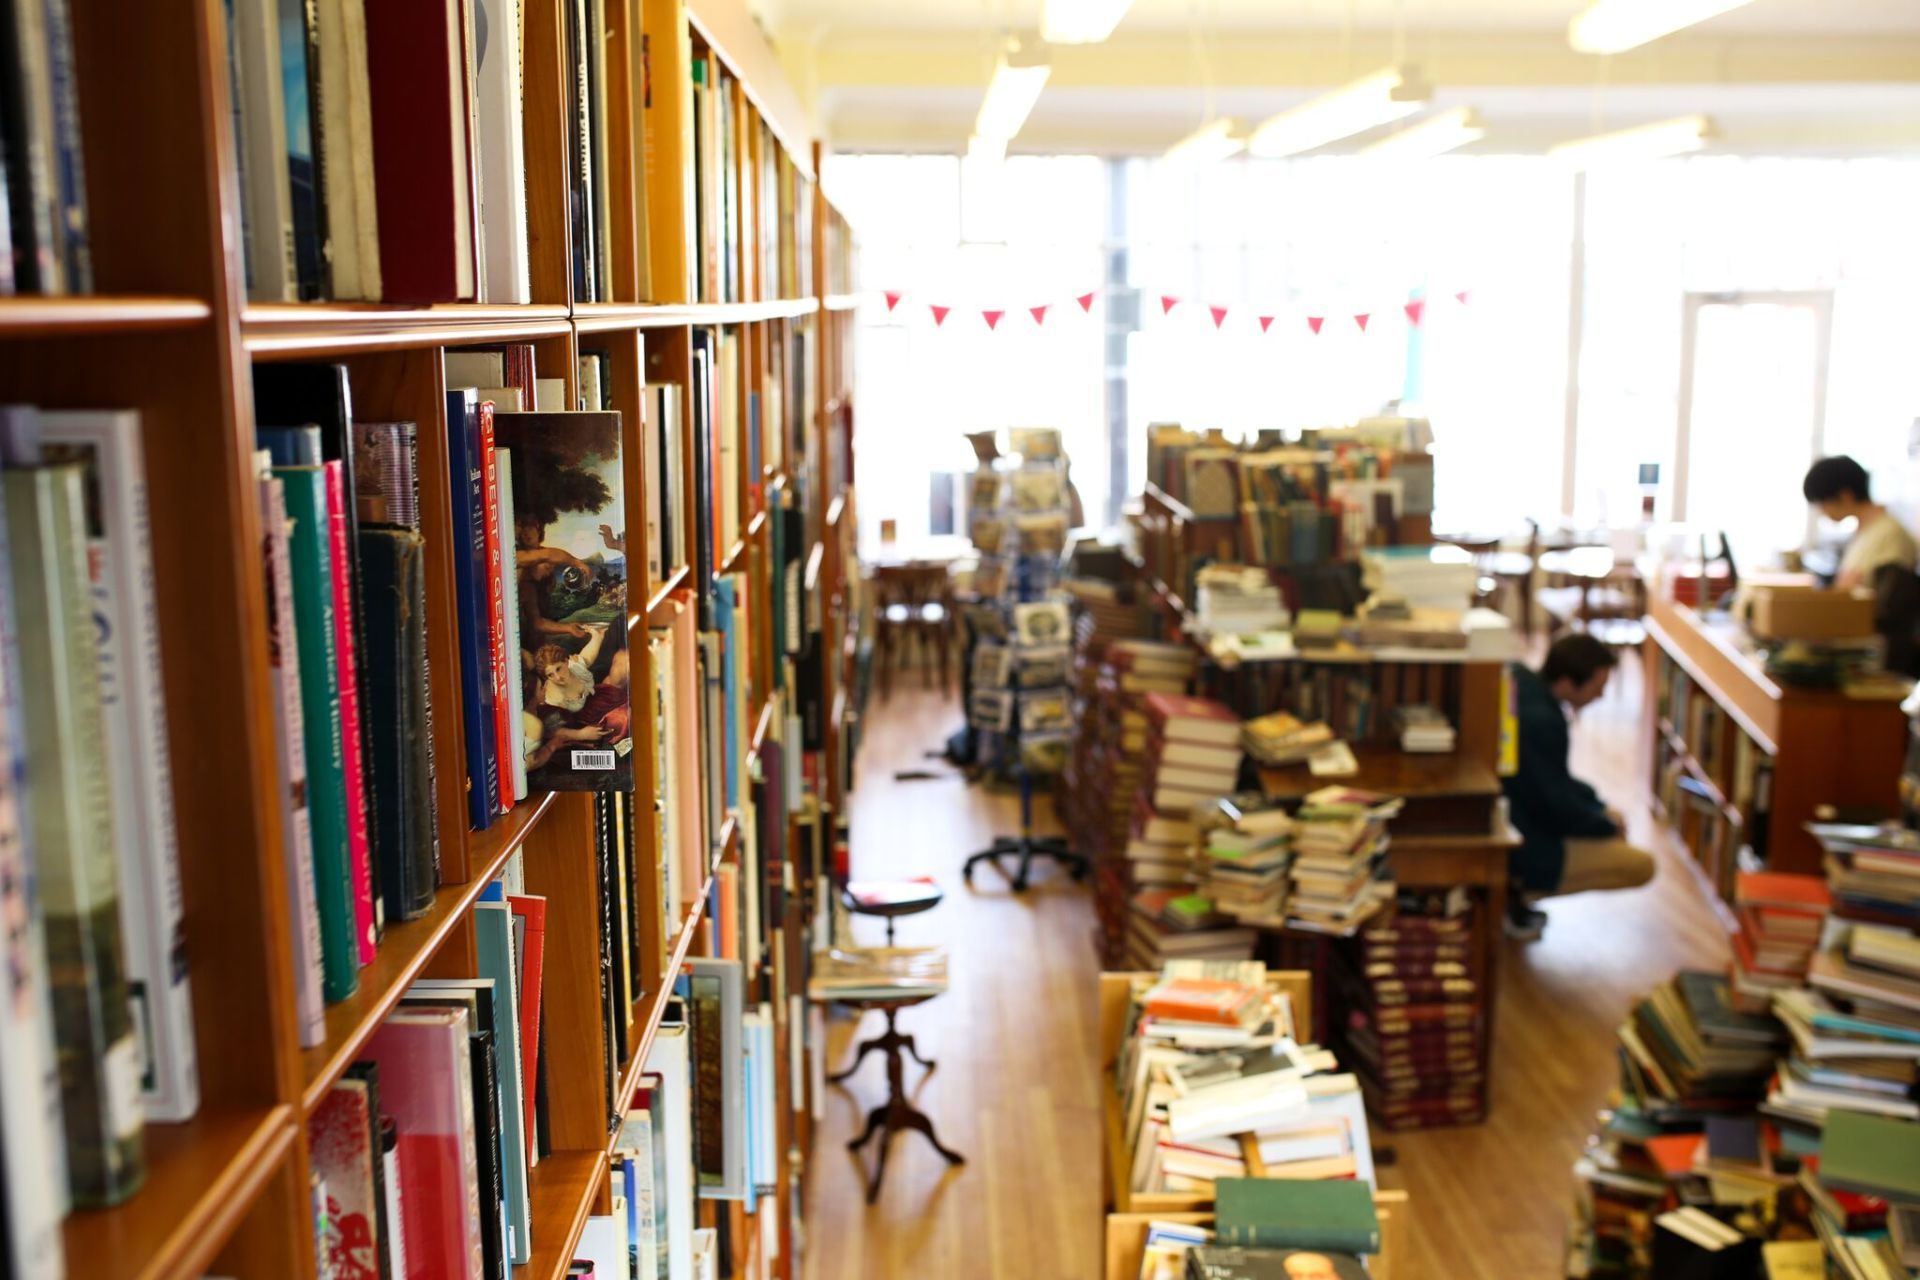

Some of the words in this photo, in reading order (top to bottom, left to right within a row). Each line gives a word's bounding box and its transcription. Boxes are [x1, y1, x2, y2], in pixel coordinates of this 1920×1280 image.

[485, 413, 499, 539] GILBERT
[492, 549, 501, 566] &
[494, 577, 508, 702] GEORGE
